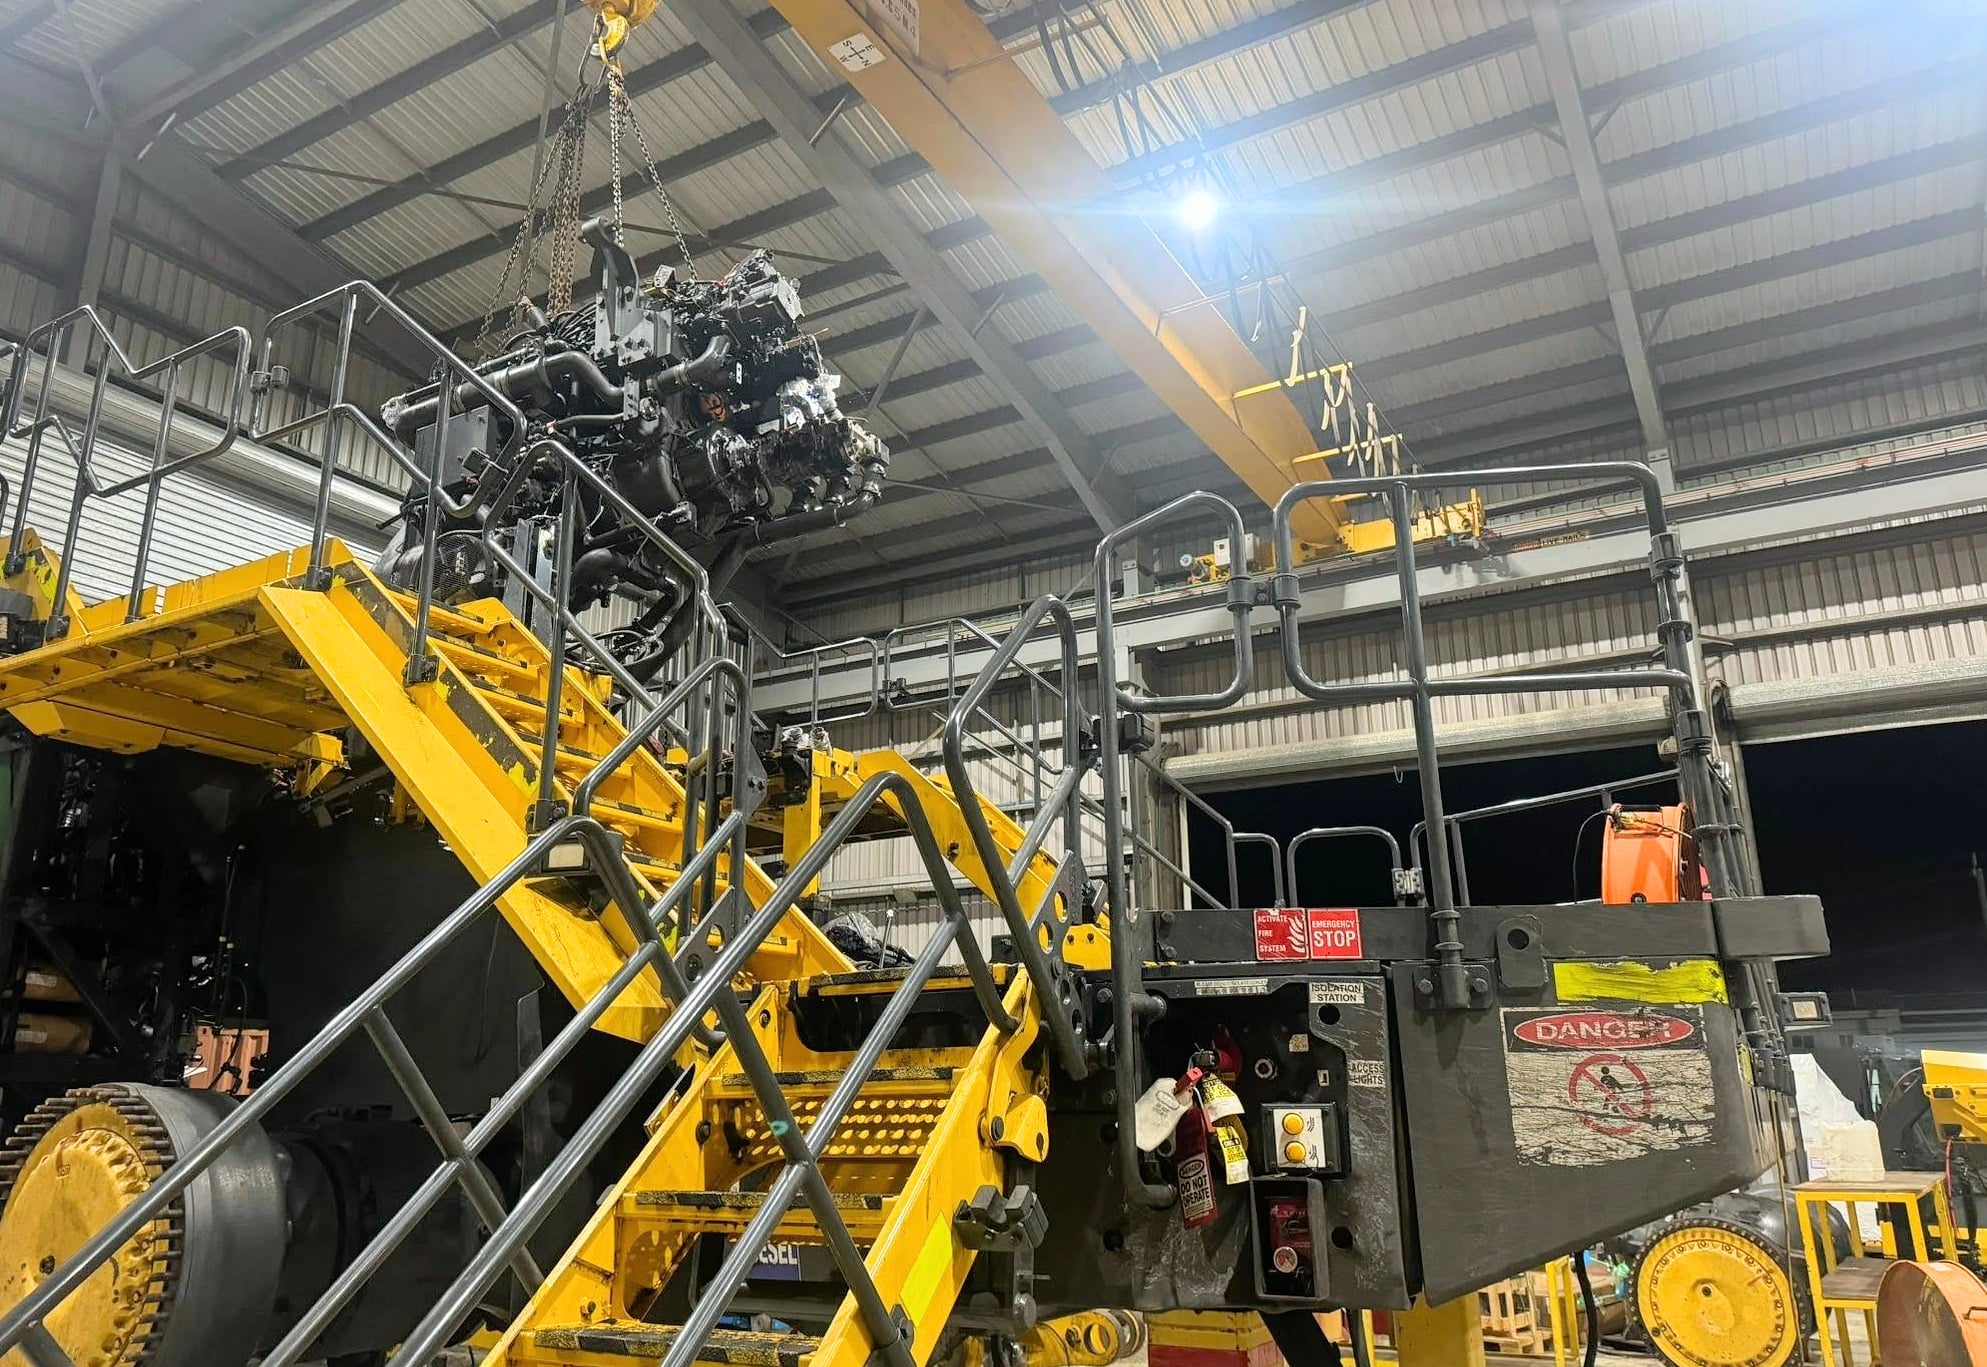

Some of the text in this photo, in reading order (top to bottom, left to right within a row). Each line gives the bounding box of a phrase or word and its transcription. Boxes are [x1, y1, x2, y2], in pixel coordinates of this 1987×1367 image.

[865, 44, 874, 52] E
[1312, 920, 1355, 928] EMERGENCY
[1258, 929, 1273, 937] FIRE
[1313, 930, 1356, 948] STOP
[1311, 983, 1361, 992] ISOLATION
[1317, 994, 1357, 1002] STATION
[1351, 1063, 1385, 1073] ACCESS
[1352, 1075, 1384, 1085] LIGHTS
[1181, 1175, 1208, 1195] DO NOT
[1182, 1187, 1210, 1208] OPERATE
[756, 1243, 798, 1265] ESEL
